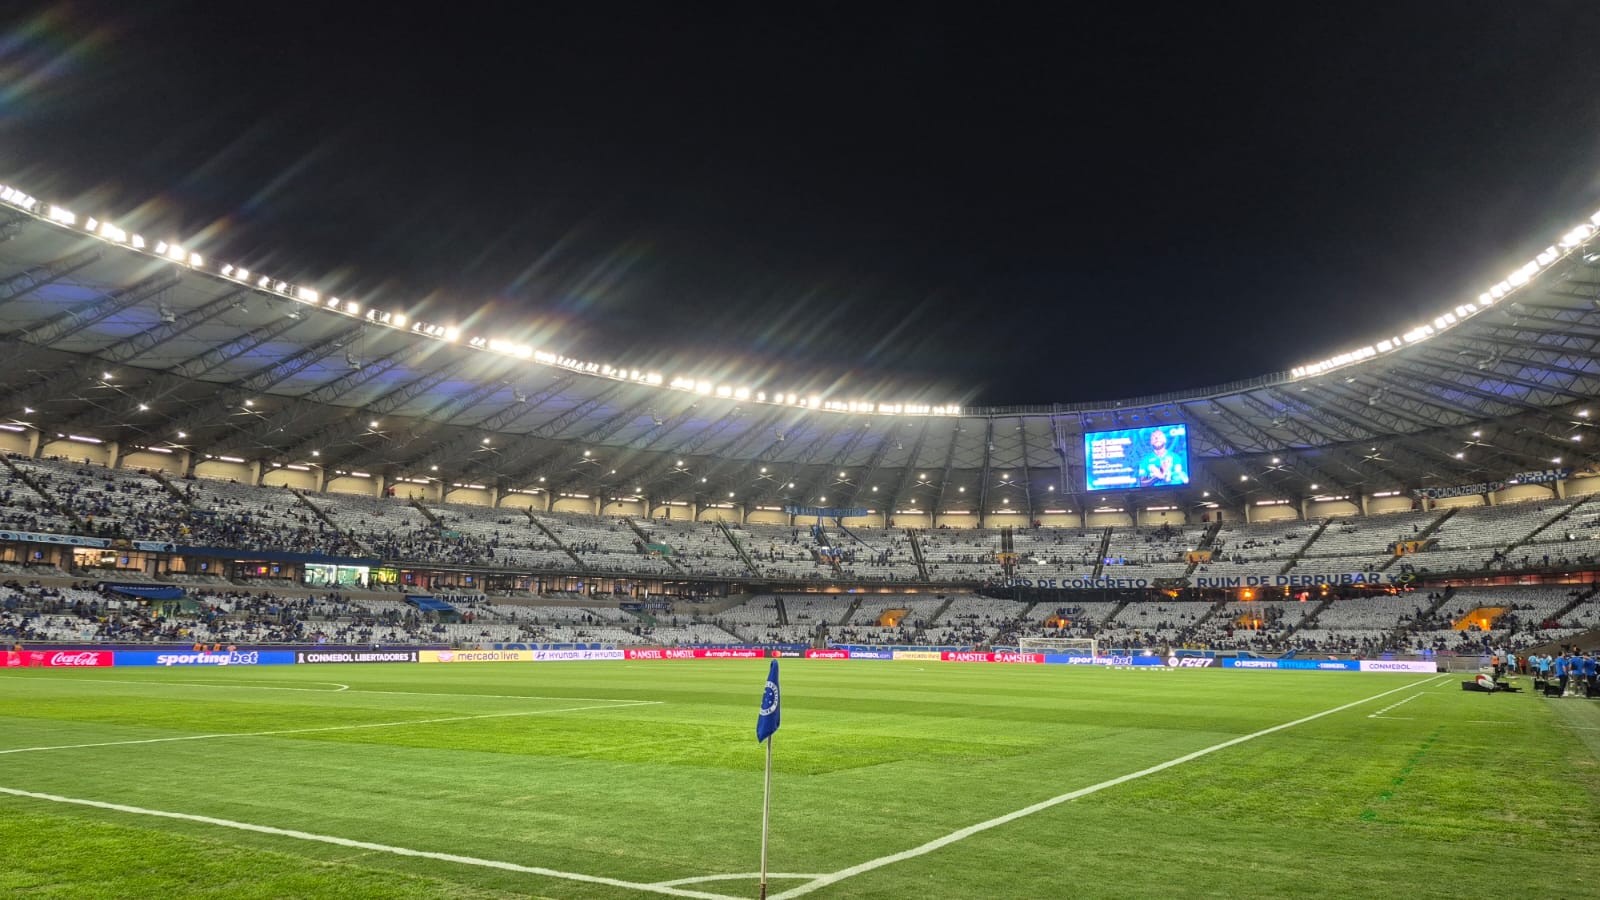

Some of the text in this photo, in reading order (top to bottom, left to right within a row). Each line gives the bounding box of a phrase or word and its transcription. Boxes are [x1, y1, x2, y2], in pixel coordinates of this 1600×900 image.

[1037, 579, 1056, 589] DE
[1062, 578, 1147, 589] CONCRETO
[1196, 576, 1240, 588] RUIM
[1246, 576, 1270, 587] DE
[1275, 573, 1381, 587] DERRUBAR
[442, 595, 479, 603] MANCHA
[157, 651, 258, 666] sportingbet
[307, 653, 408, 662] CONMEBOL LIBERTADORES
[458, 651, 519, 660] mercado livre
[637, 650, 662, 659] AMSTEL
[672, 650, 695, 658] AMSTEL
[956, 653, 988, 662] AMSTEL
[1003, 654, 1036, 663] AMSTEL
